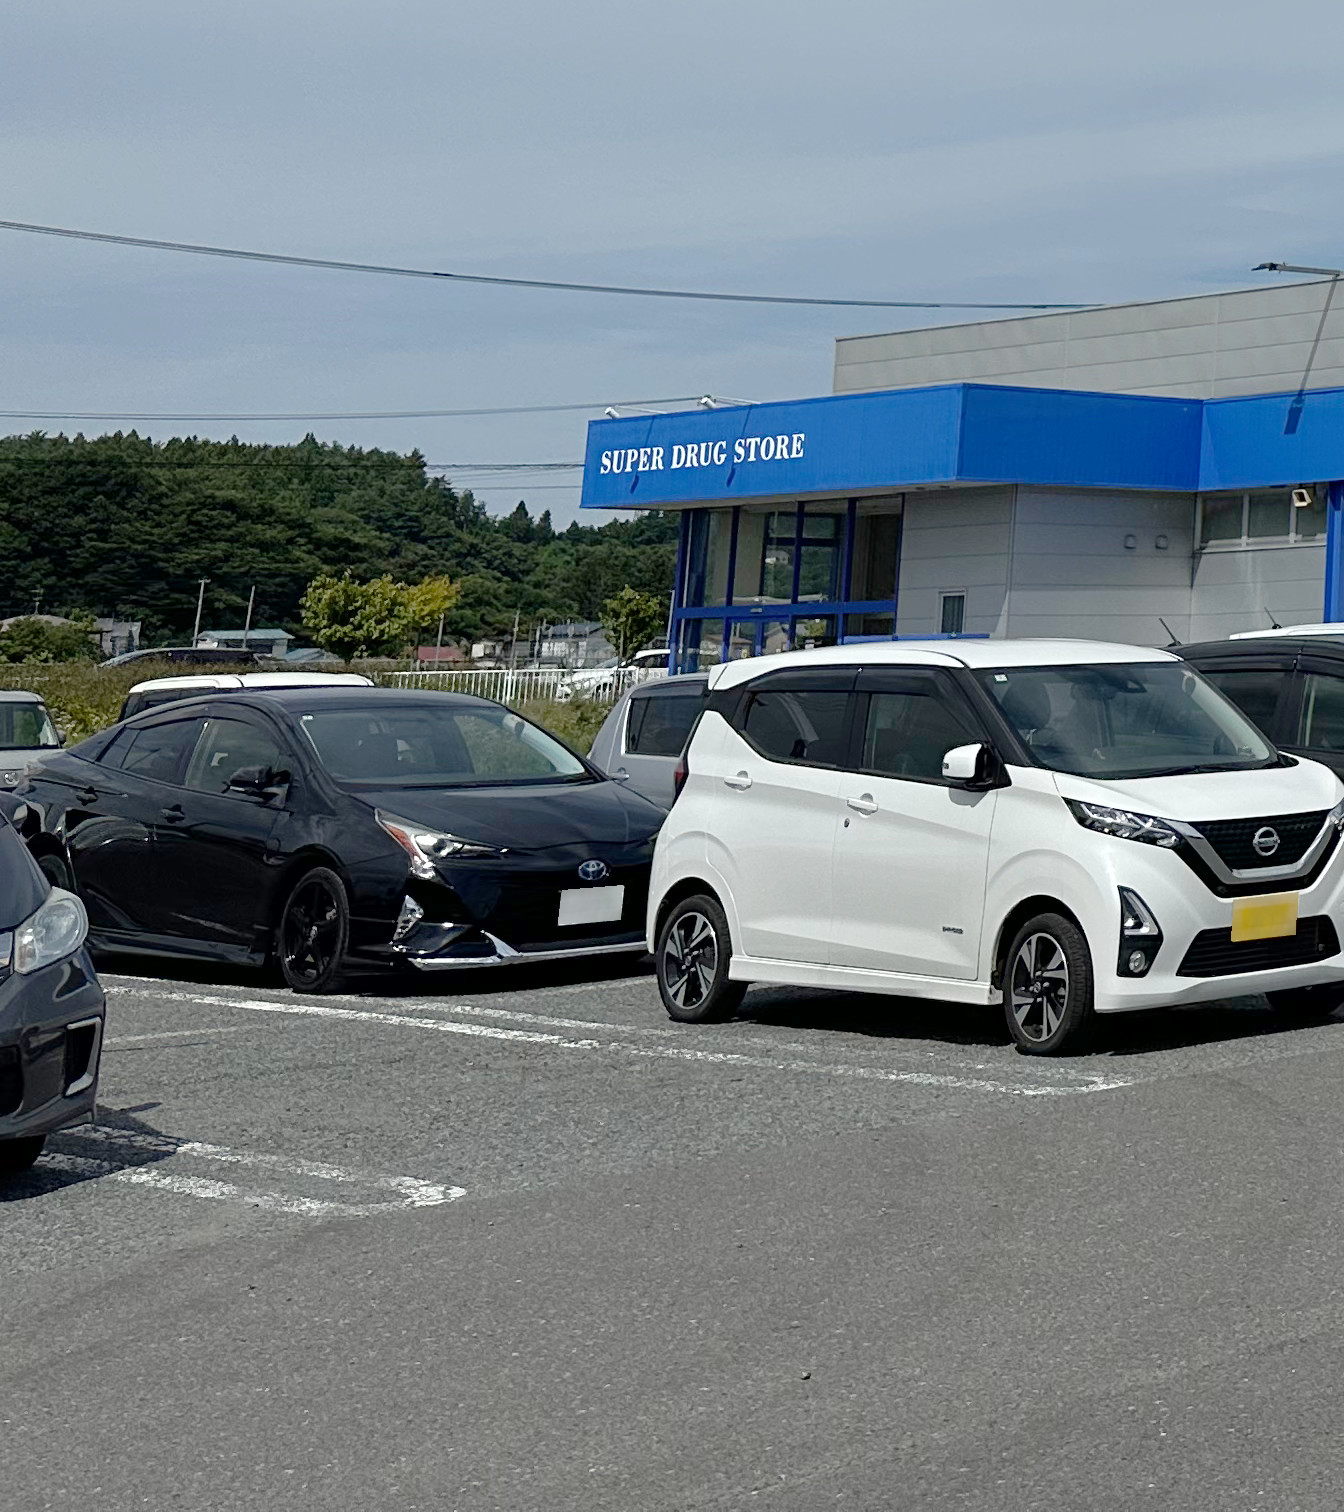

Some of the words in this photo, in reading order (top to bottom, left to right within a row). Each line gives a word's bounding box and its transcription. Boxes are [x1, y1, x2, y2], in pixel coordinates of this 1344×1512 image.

[600, 446, 664, 474] SUPER
[670, 441, 728, 469] DRUG
[733, 433, 806, 464] STORE
